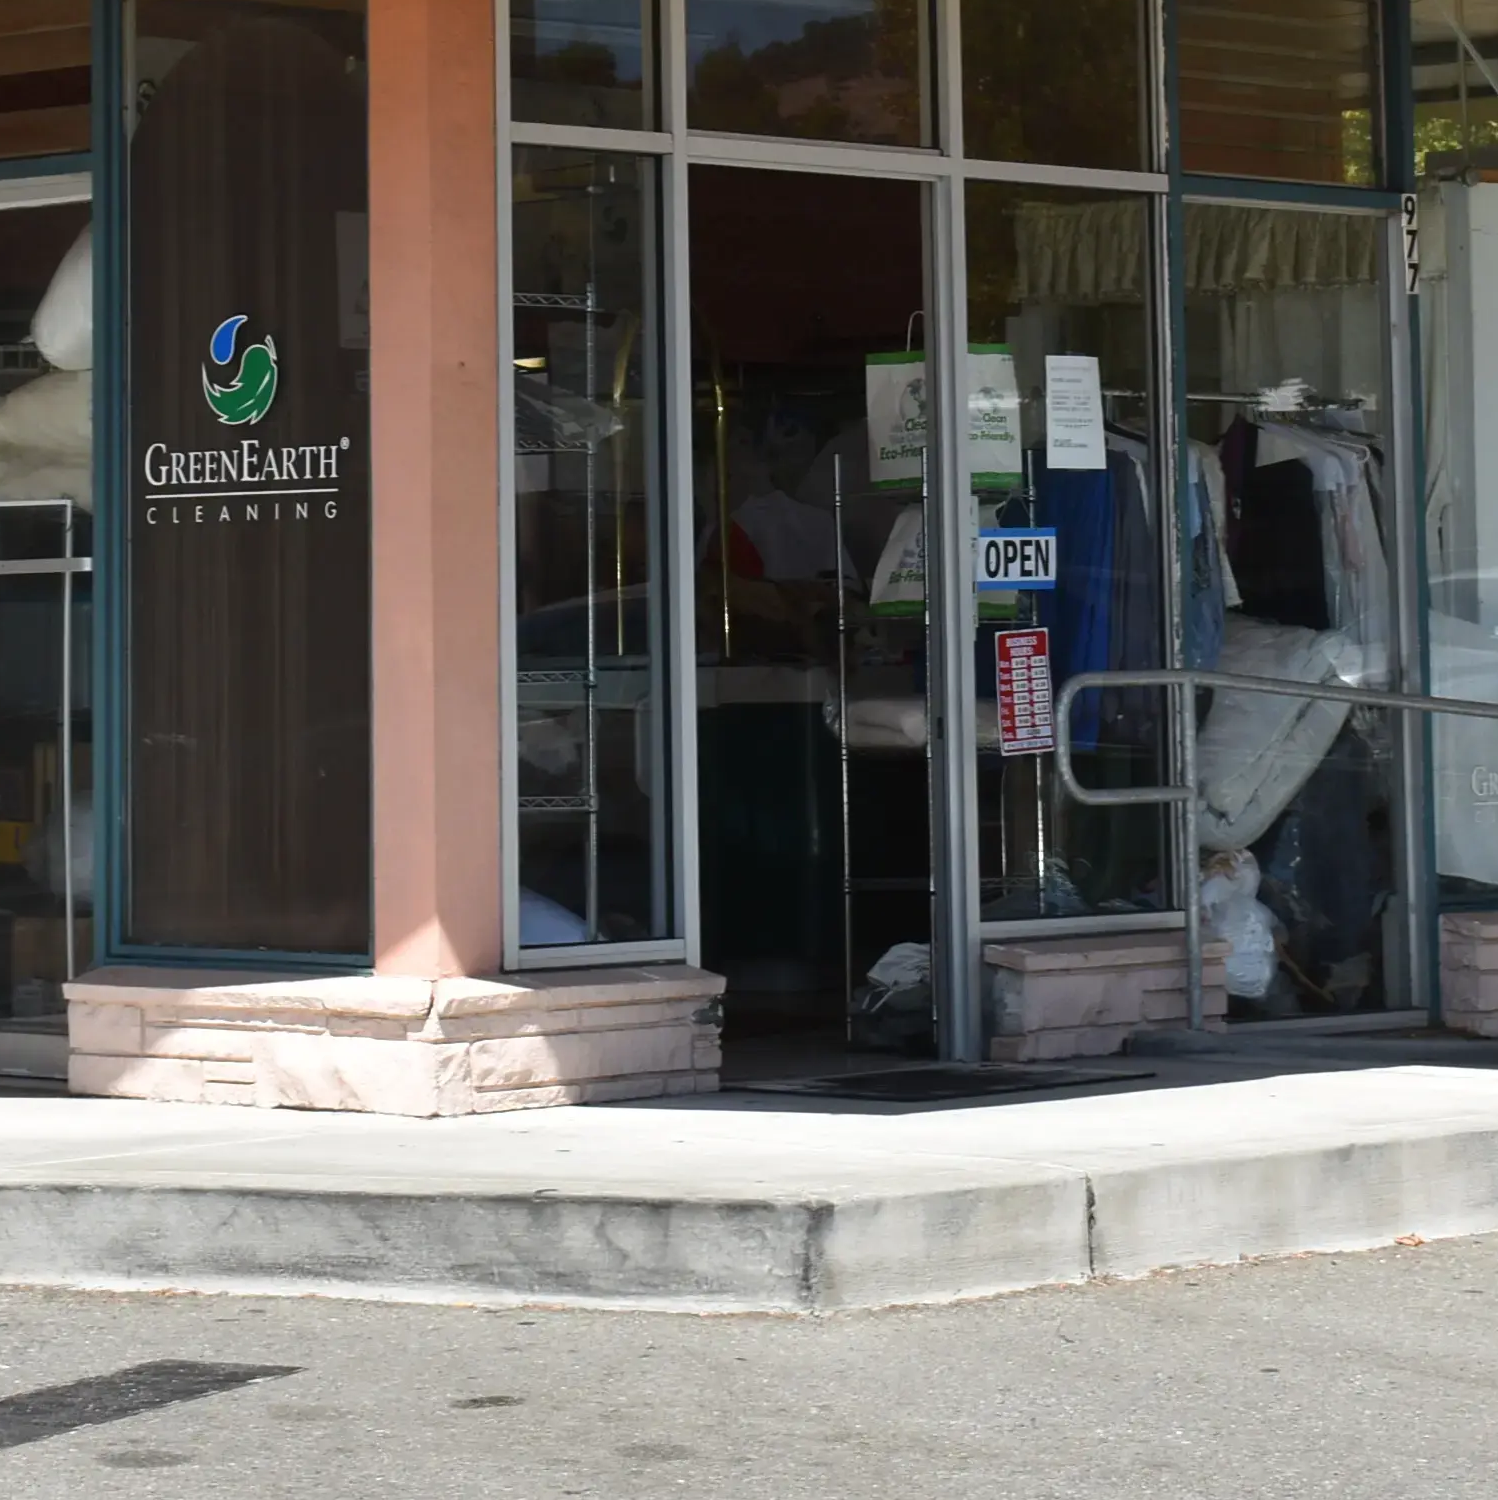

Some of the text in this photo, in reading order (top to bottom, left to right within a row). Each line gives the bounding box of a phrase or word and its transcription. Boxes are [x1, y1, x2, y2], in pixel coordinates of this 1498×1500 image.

[1403, 195, 1419, 292] 977
[146, 501, 338, 525] CLEANING
[984, 539, 1049, 578] OPEN
